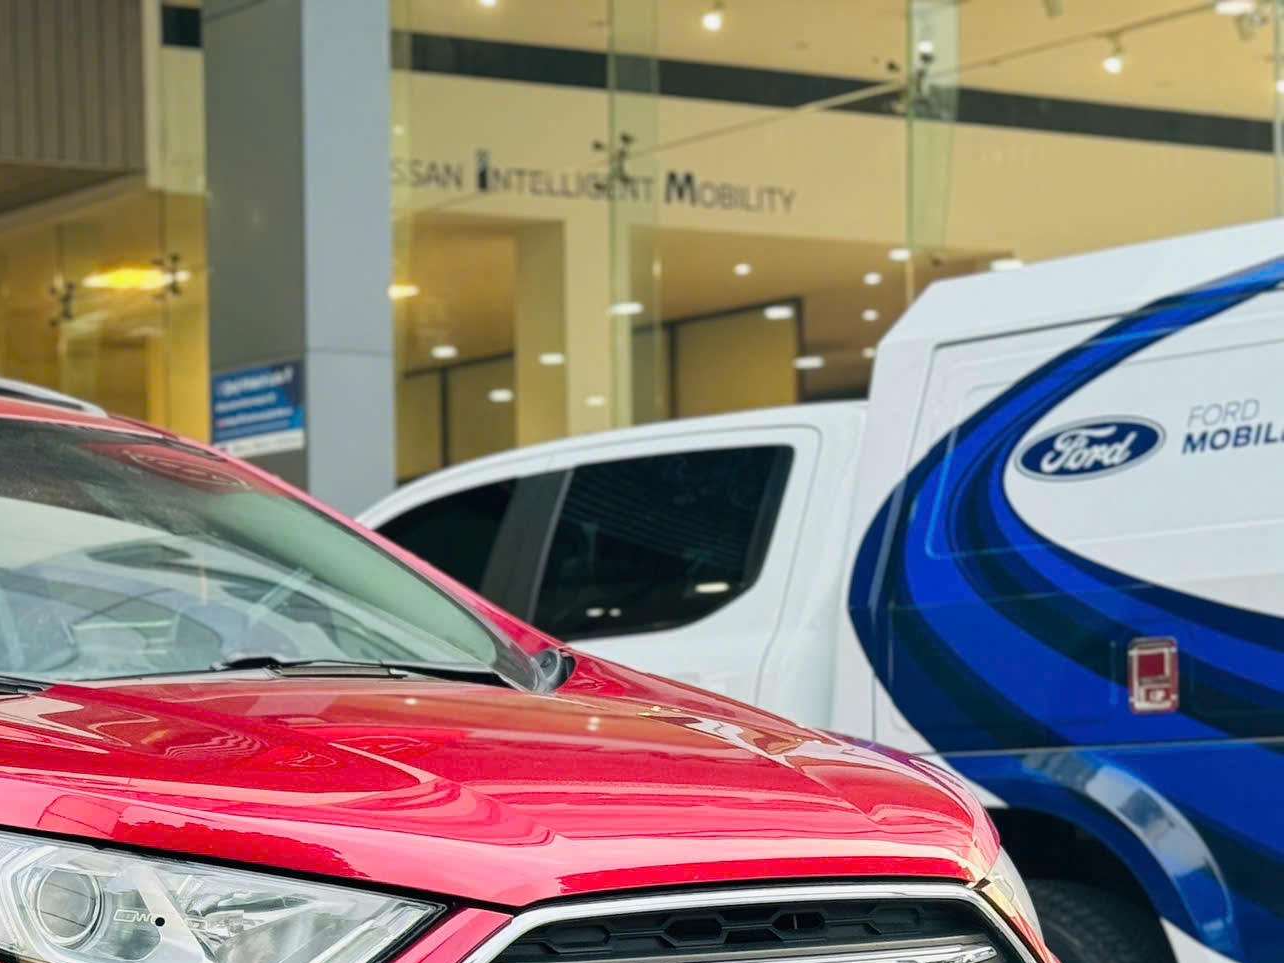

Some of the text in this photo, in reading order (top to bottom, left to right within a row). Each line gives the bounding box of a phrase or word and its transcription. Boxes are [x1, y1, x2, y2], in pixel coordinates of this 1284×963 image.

[665, 170, 796, 214] MOBILITY
[1186, 398, 1261, 427] FORD
[1040, 424, 1139, 474] Ford
[1181, 421, 1284, 455] MOBIL
